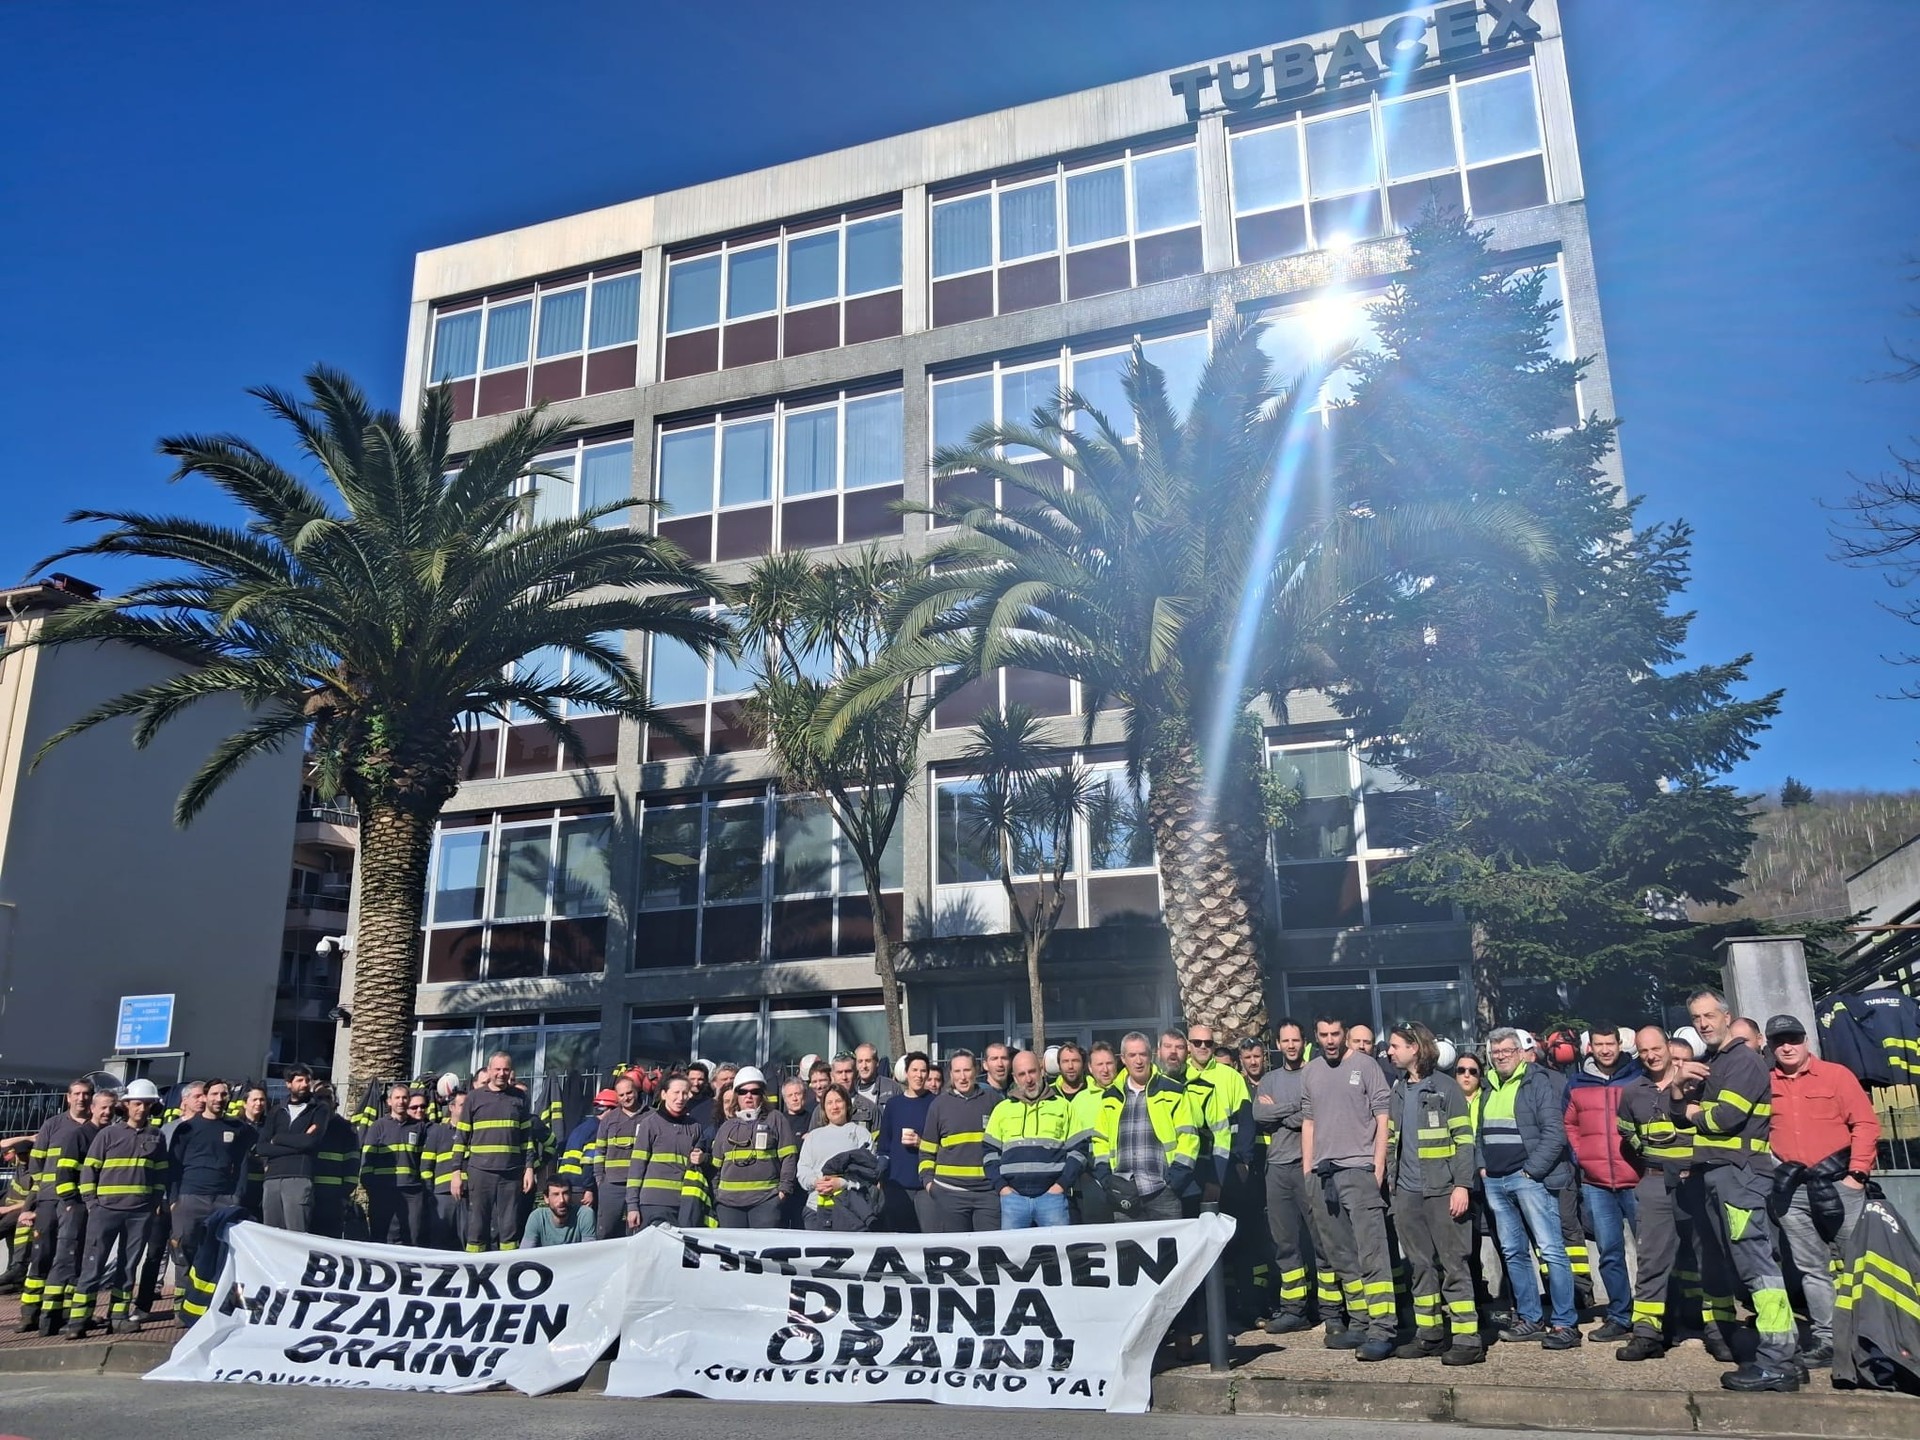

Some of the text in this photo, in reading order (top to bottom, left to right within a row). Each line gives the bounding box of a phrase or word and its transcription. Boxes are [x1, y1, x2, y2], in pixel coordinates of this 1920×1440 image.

[1169, 0, 1541, 121] TUBACEX
[300, 1249, 554, 1300] BIDEZKO
[681, 1235, 1179, 1288] HITZARMEN
[218, 1281, 570, 1345] HITZARMEN
[787, 1278, 1063, 1339] DUINA
[283, 1334, 510, 1378] ORAIN!
[904, 1369, 1028, 1393] DIGNO
[1047, 1376, 1108, 1398] YA!
